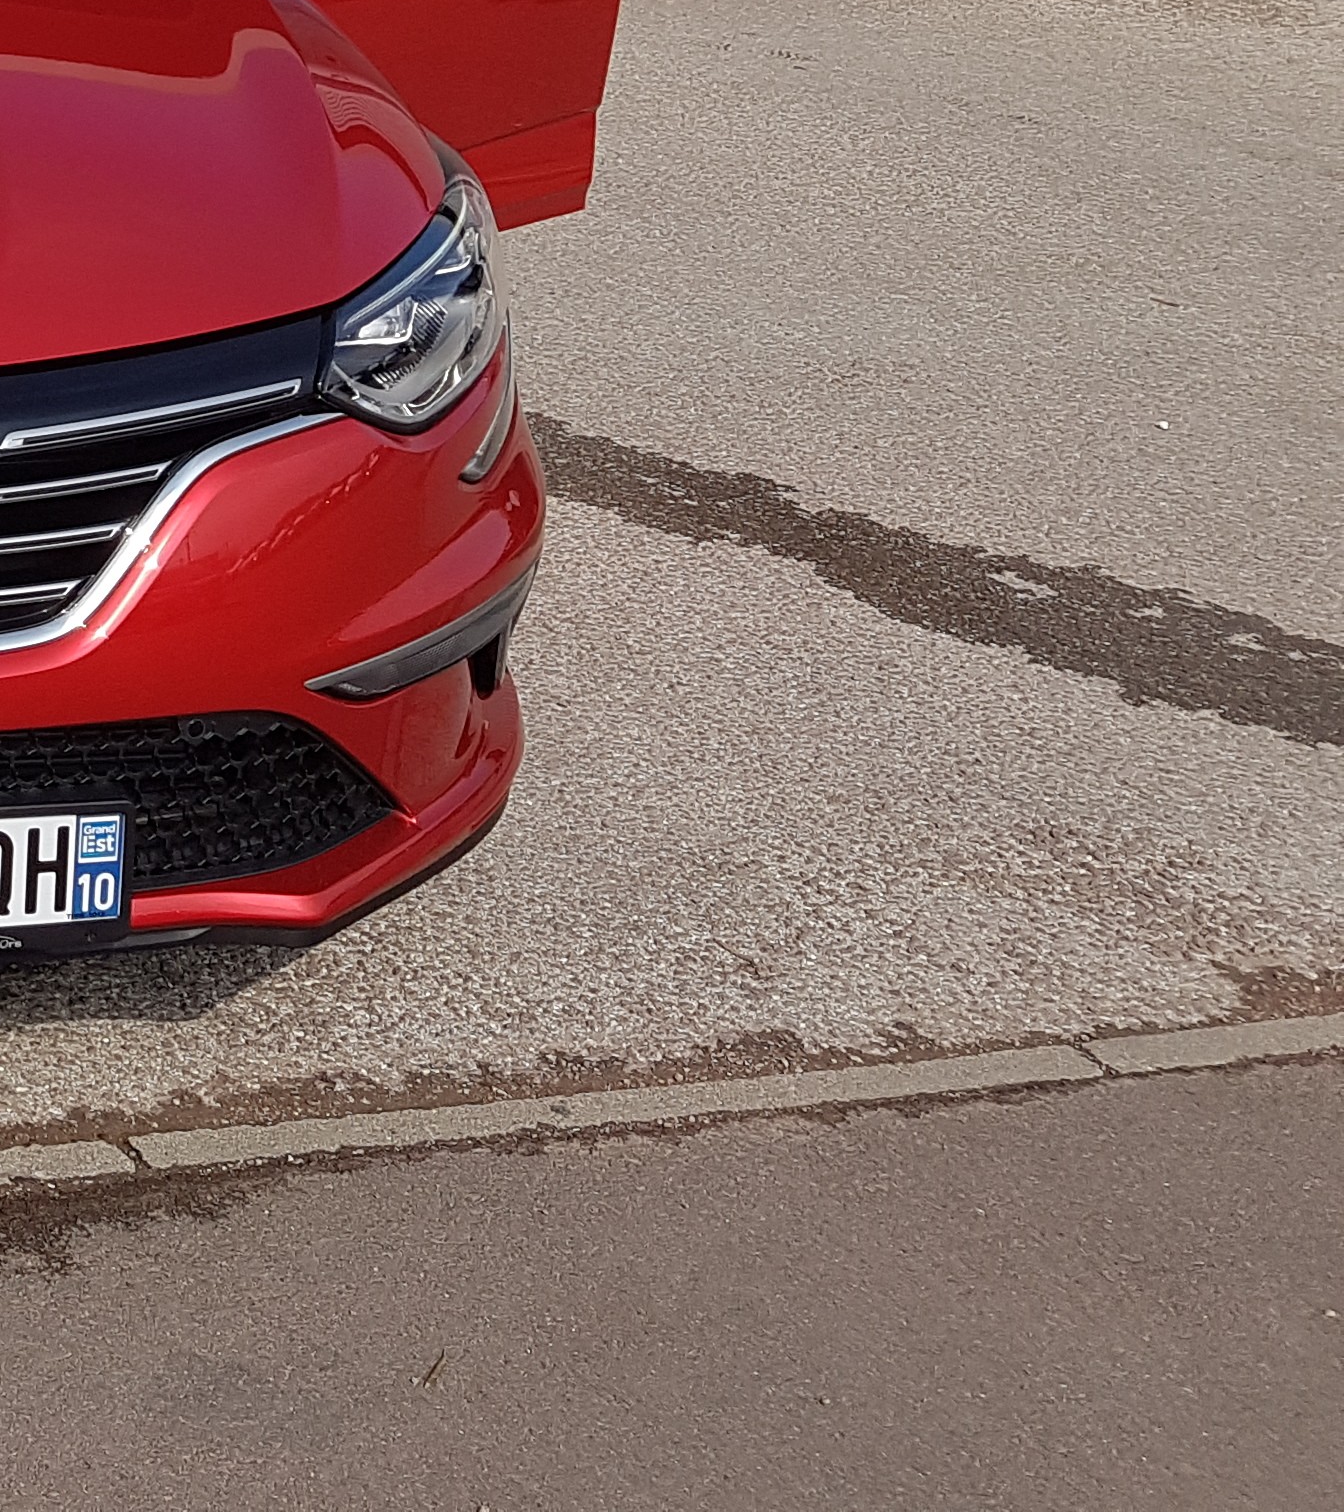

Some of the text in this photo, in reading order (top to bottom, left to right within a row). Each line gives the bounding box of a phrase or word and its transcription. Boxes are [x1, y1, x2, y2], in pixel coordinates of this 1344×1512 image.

[83, 824, 116, 835] Grand
[82, 834, 115, 853] Est
[78, 872, 116, 913] 10
